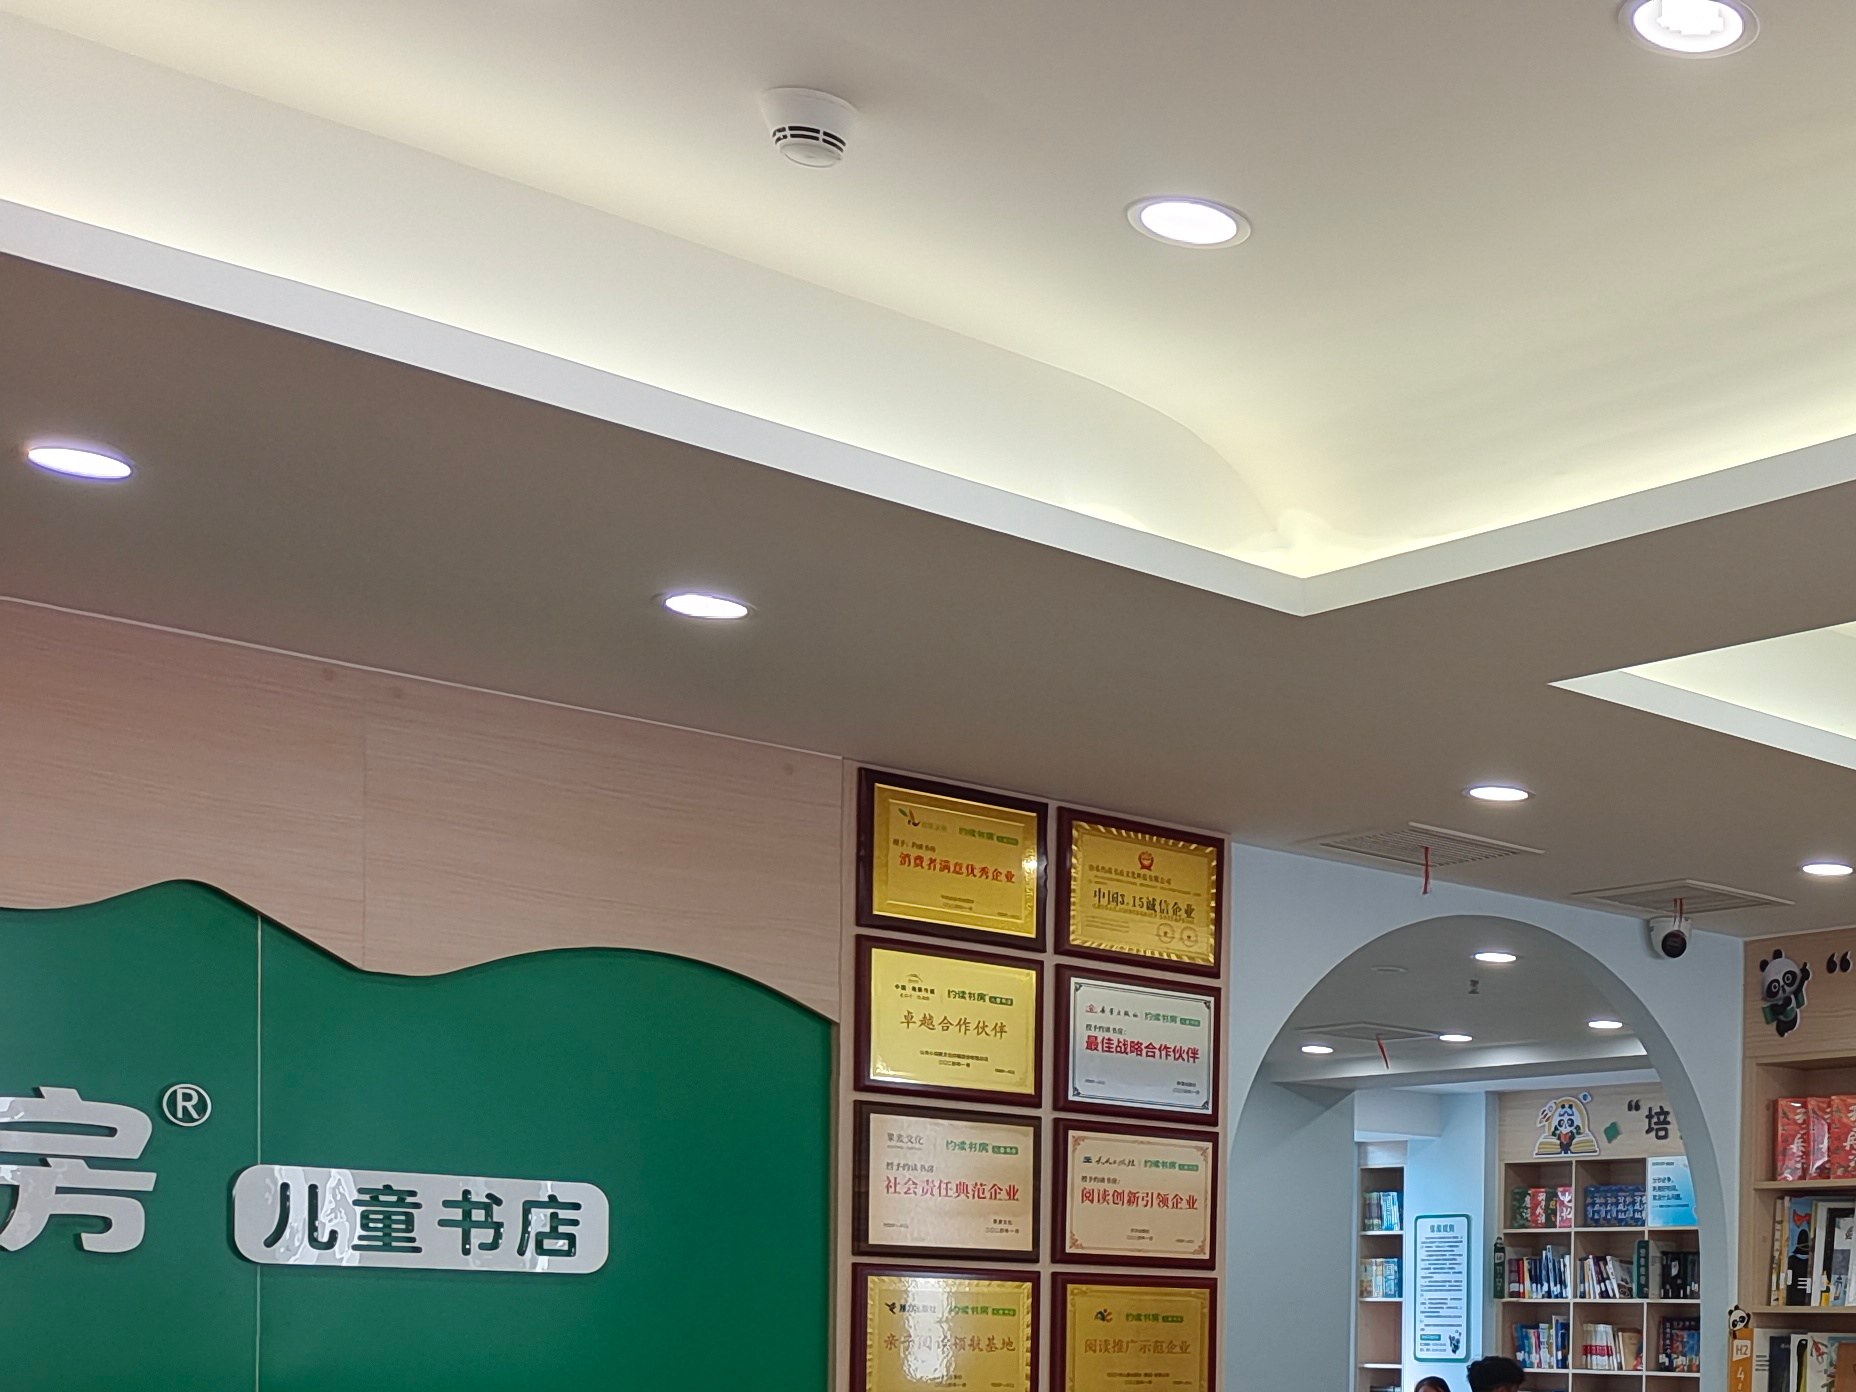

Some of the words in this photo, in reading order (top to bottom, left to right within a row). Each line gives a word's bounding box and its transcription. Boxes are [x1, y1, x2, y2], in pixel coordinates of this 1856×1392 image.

[899, 851, 1016, 884] 消费者满意优秀企业
[900, 1009, 1008, 1039] 卓越合作伙伴
[1085, 1035, 1200, 1064] 最佳战略合作伙伴
[884, 1175, 1020, 1202] 社会责任典范企业
[1080, 1187, 1198, 1211] 阅读创新引领企业
[262, 1183, 583, 1257] 儿童书店
[1735, 1344, 1749, 1356] H2
